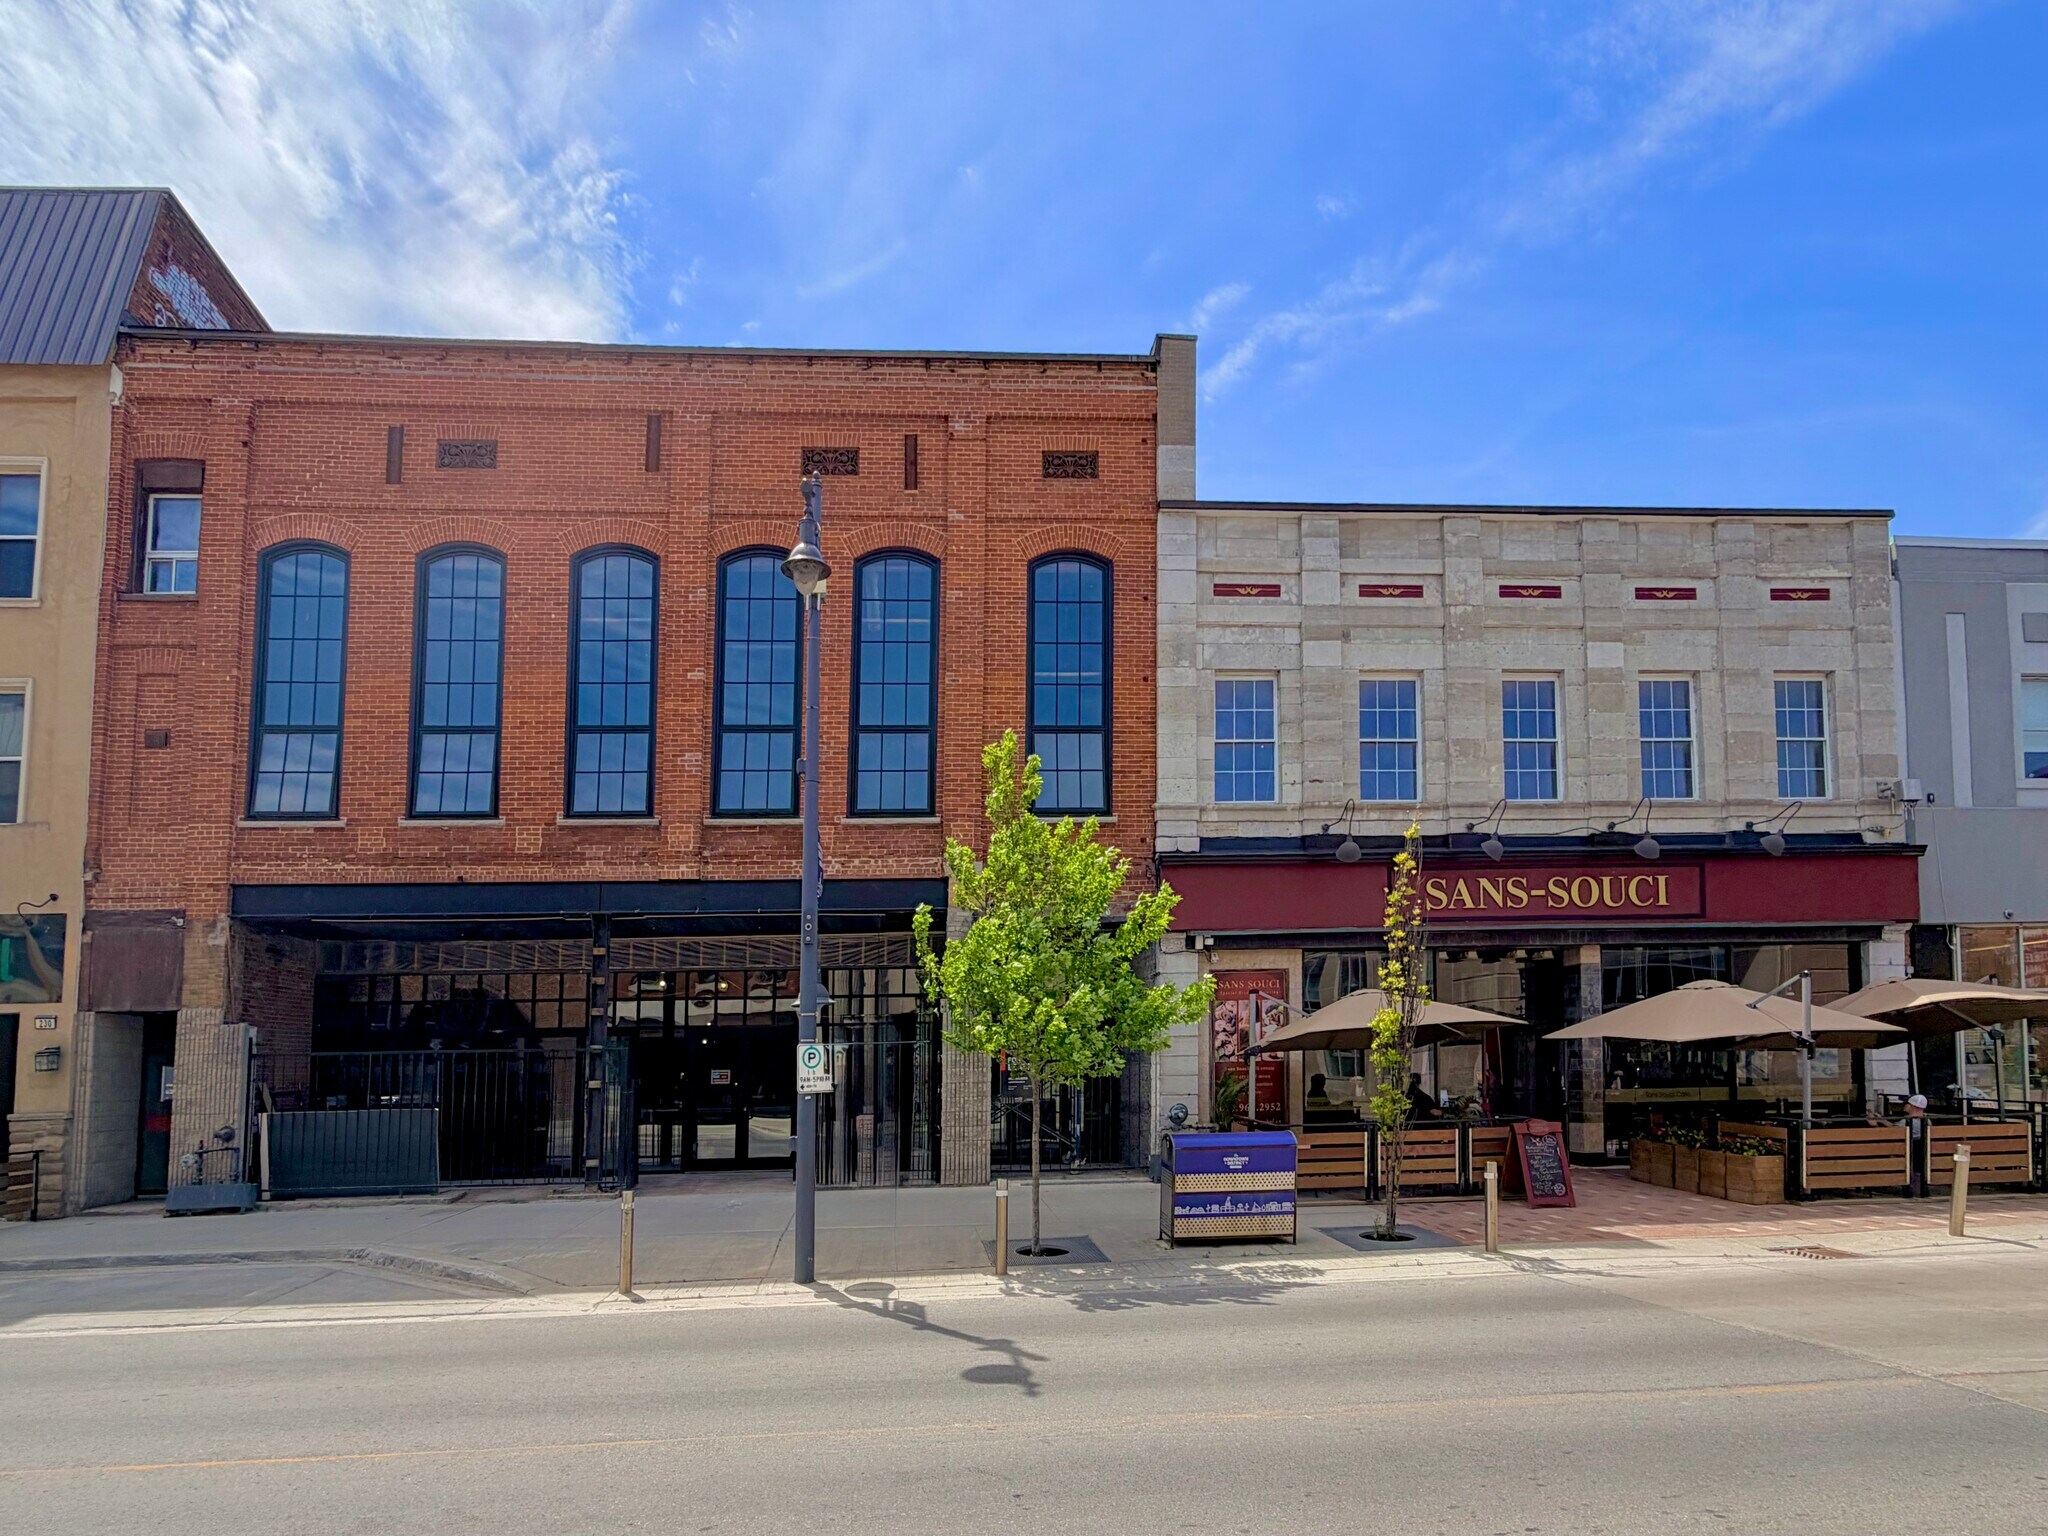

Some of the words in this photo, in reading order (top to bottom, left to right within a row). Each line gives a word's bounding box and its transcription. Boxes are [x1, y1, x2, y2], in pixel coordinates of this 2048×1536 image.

[1425, 874, 1670, 910] SANS-SOUCI
[1218, 980, 1244, 989] SANS
[1247, 979, 1280, 989] SOUCI
[39, 1019, 52, 1028] 230
[808, 1052, 816, 1063] P
